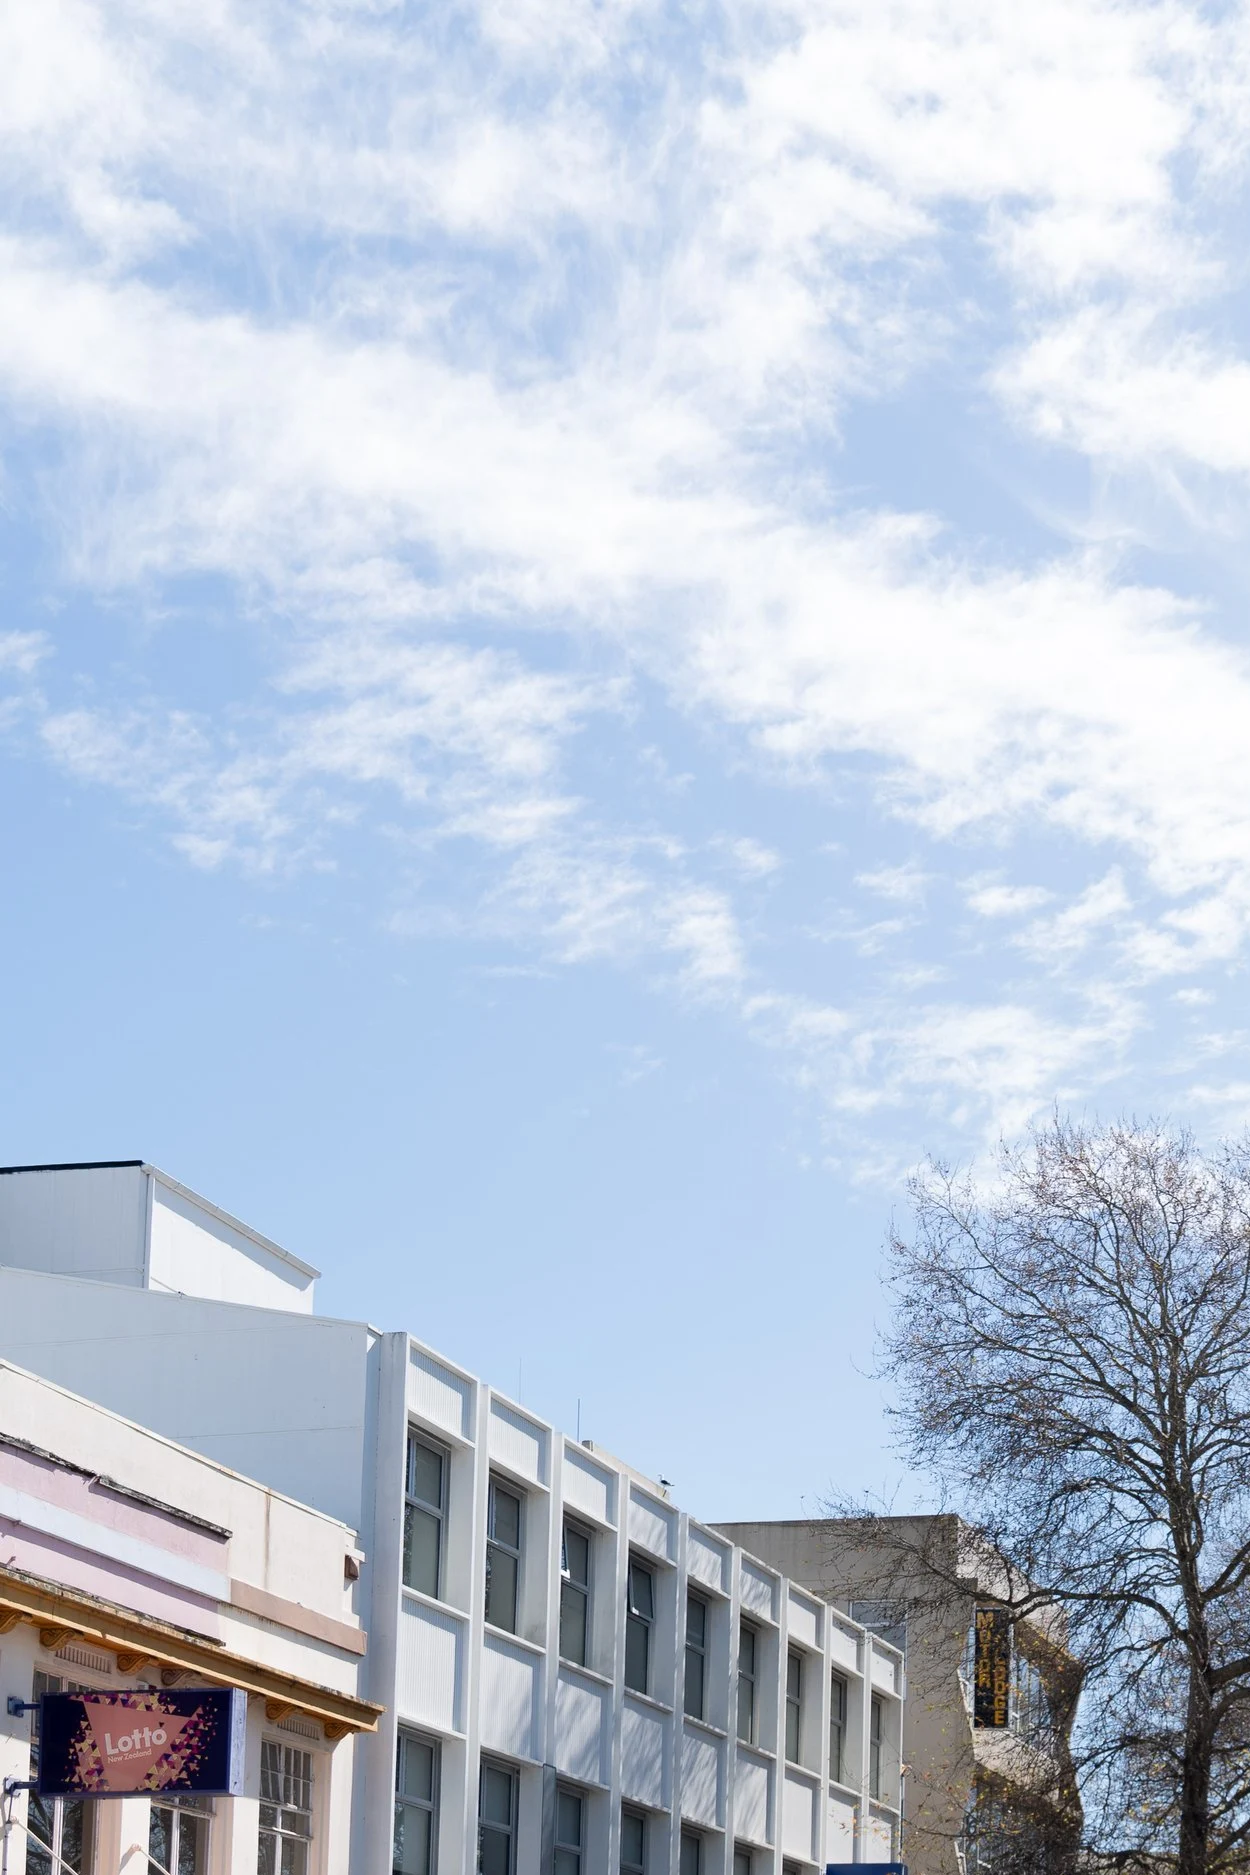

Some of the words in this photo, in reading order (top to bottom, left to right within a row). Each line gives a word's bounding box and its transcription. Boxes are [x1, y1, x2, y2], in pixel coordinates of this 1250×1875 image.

[104, 1726, 168, 1755] Lotto
[107, 1754, 123, 1764] New
[123, 1749, 152, 1761] Zealand
